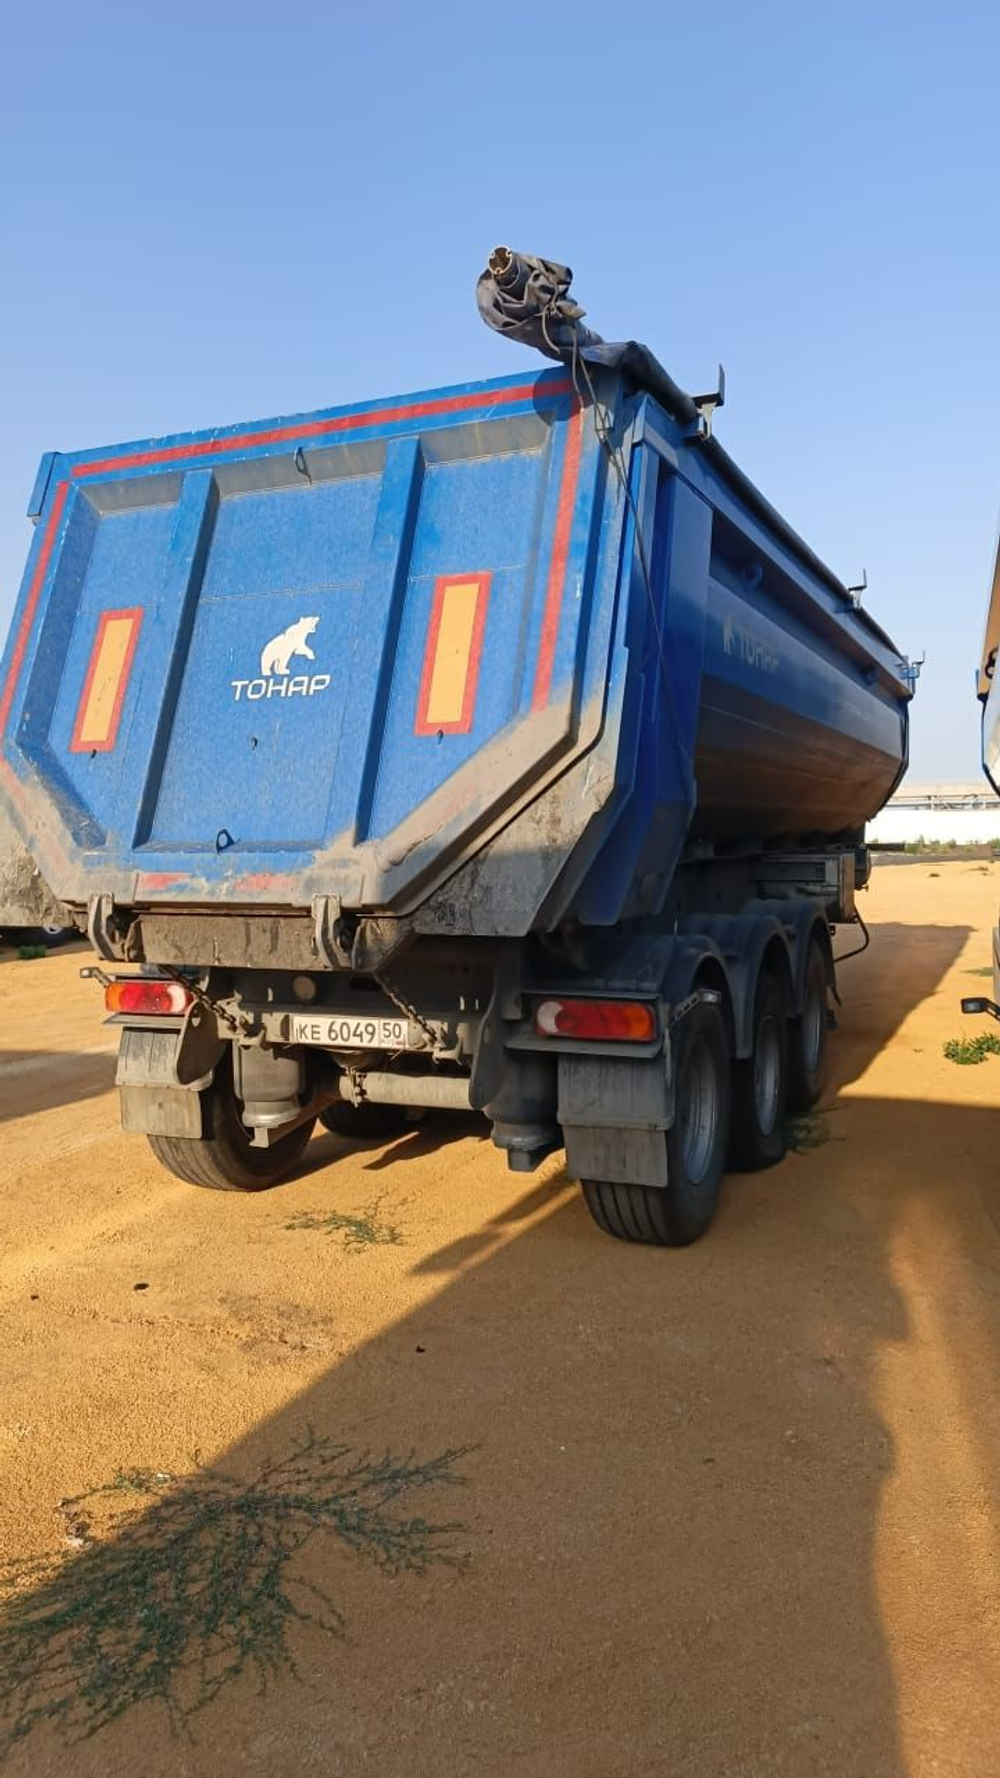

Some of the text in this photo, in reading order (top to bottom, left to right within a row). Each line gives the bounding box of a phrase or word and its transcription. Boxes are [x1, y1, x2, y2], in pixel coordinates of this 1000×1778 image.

[231, 674, 331, 701] ТОНАР
[299, 1021, 402, 1043] КЕ 6049 50
